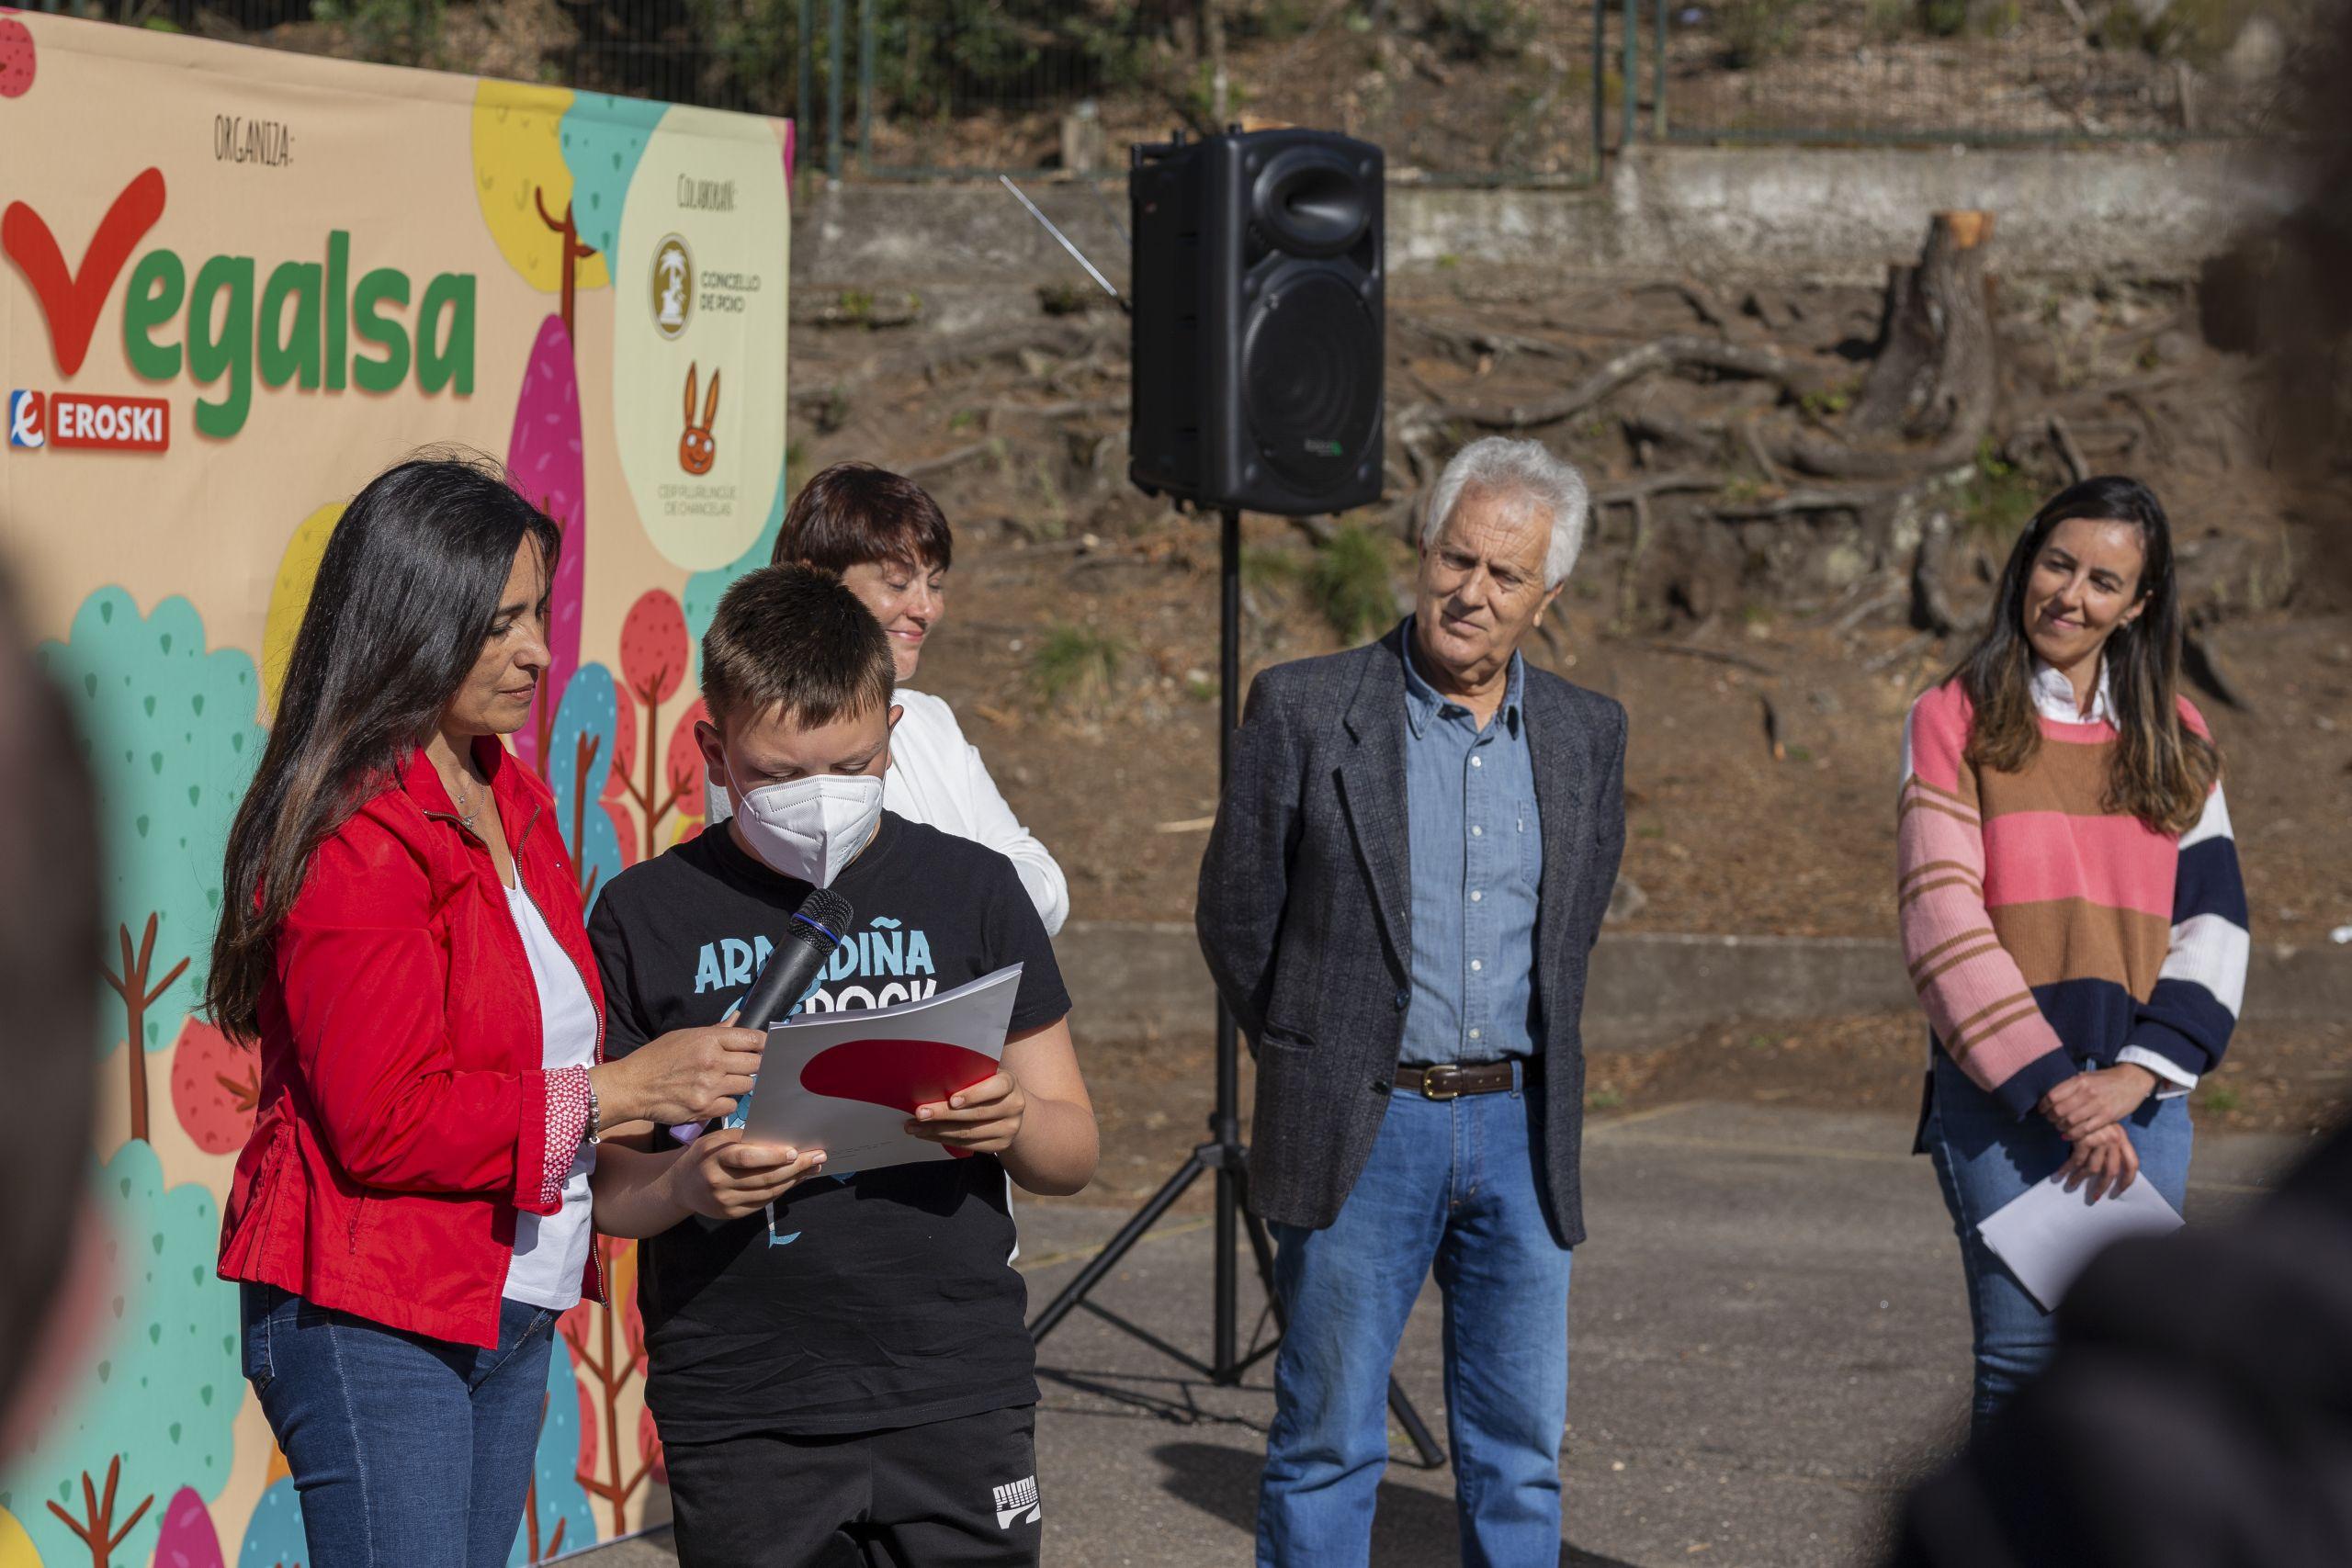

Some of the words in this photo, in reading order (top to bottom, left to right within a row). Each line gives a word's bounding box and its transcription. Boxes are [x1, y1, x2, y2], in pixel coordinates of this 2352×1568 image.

[214, 114, 295, 167] ORGANIZA:
[699, 271, 761, 291] CONCELLO
[2, 166, 477, 439] Vegalsa
[699, 293, 715, 311] DE
[57, 402, 164, 442] EROSKI
[993, 1475, 1038, 1512] PUMA
